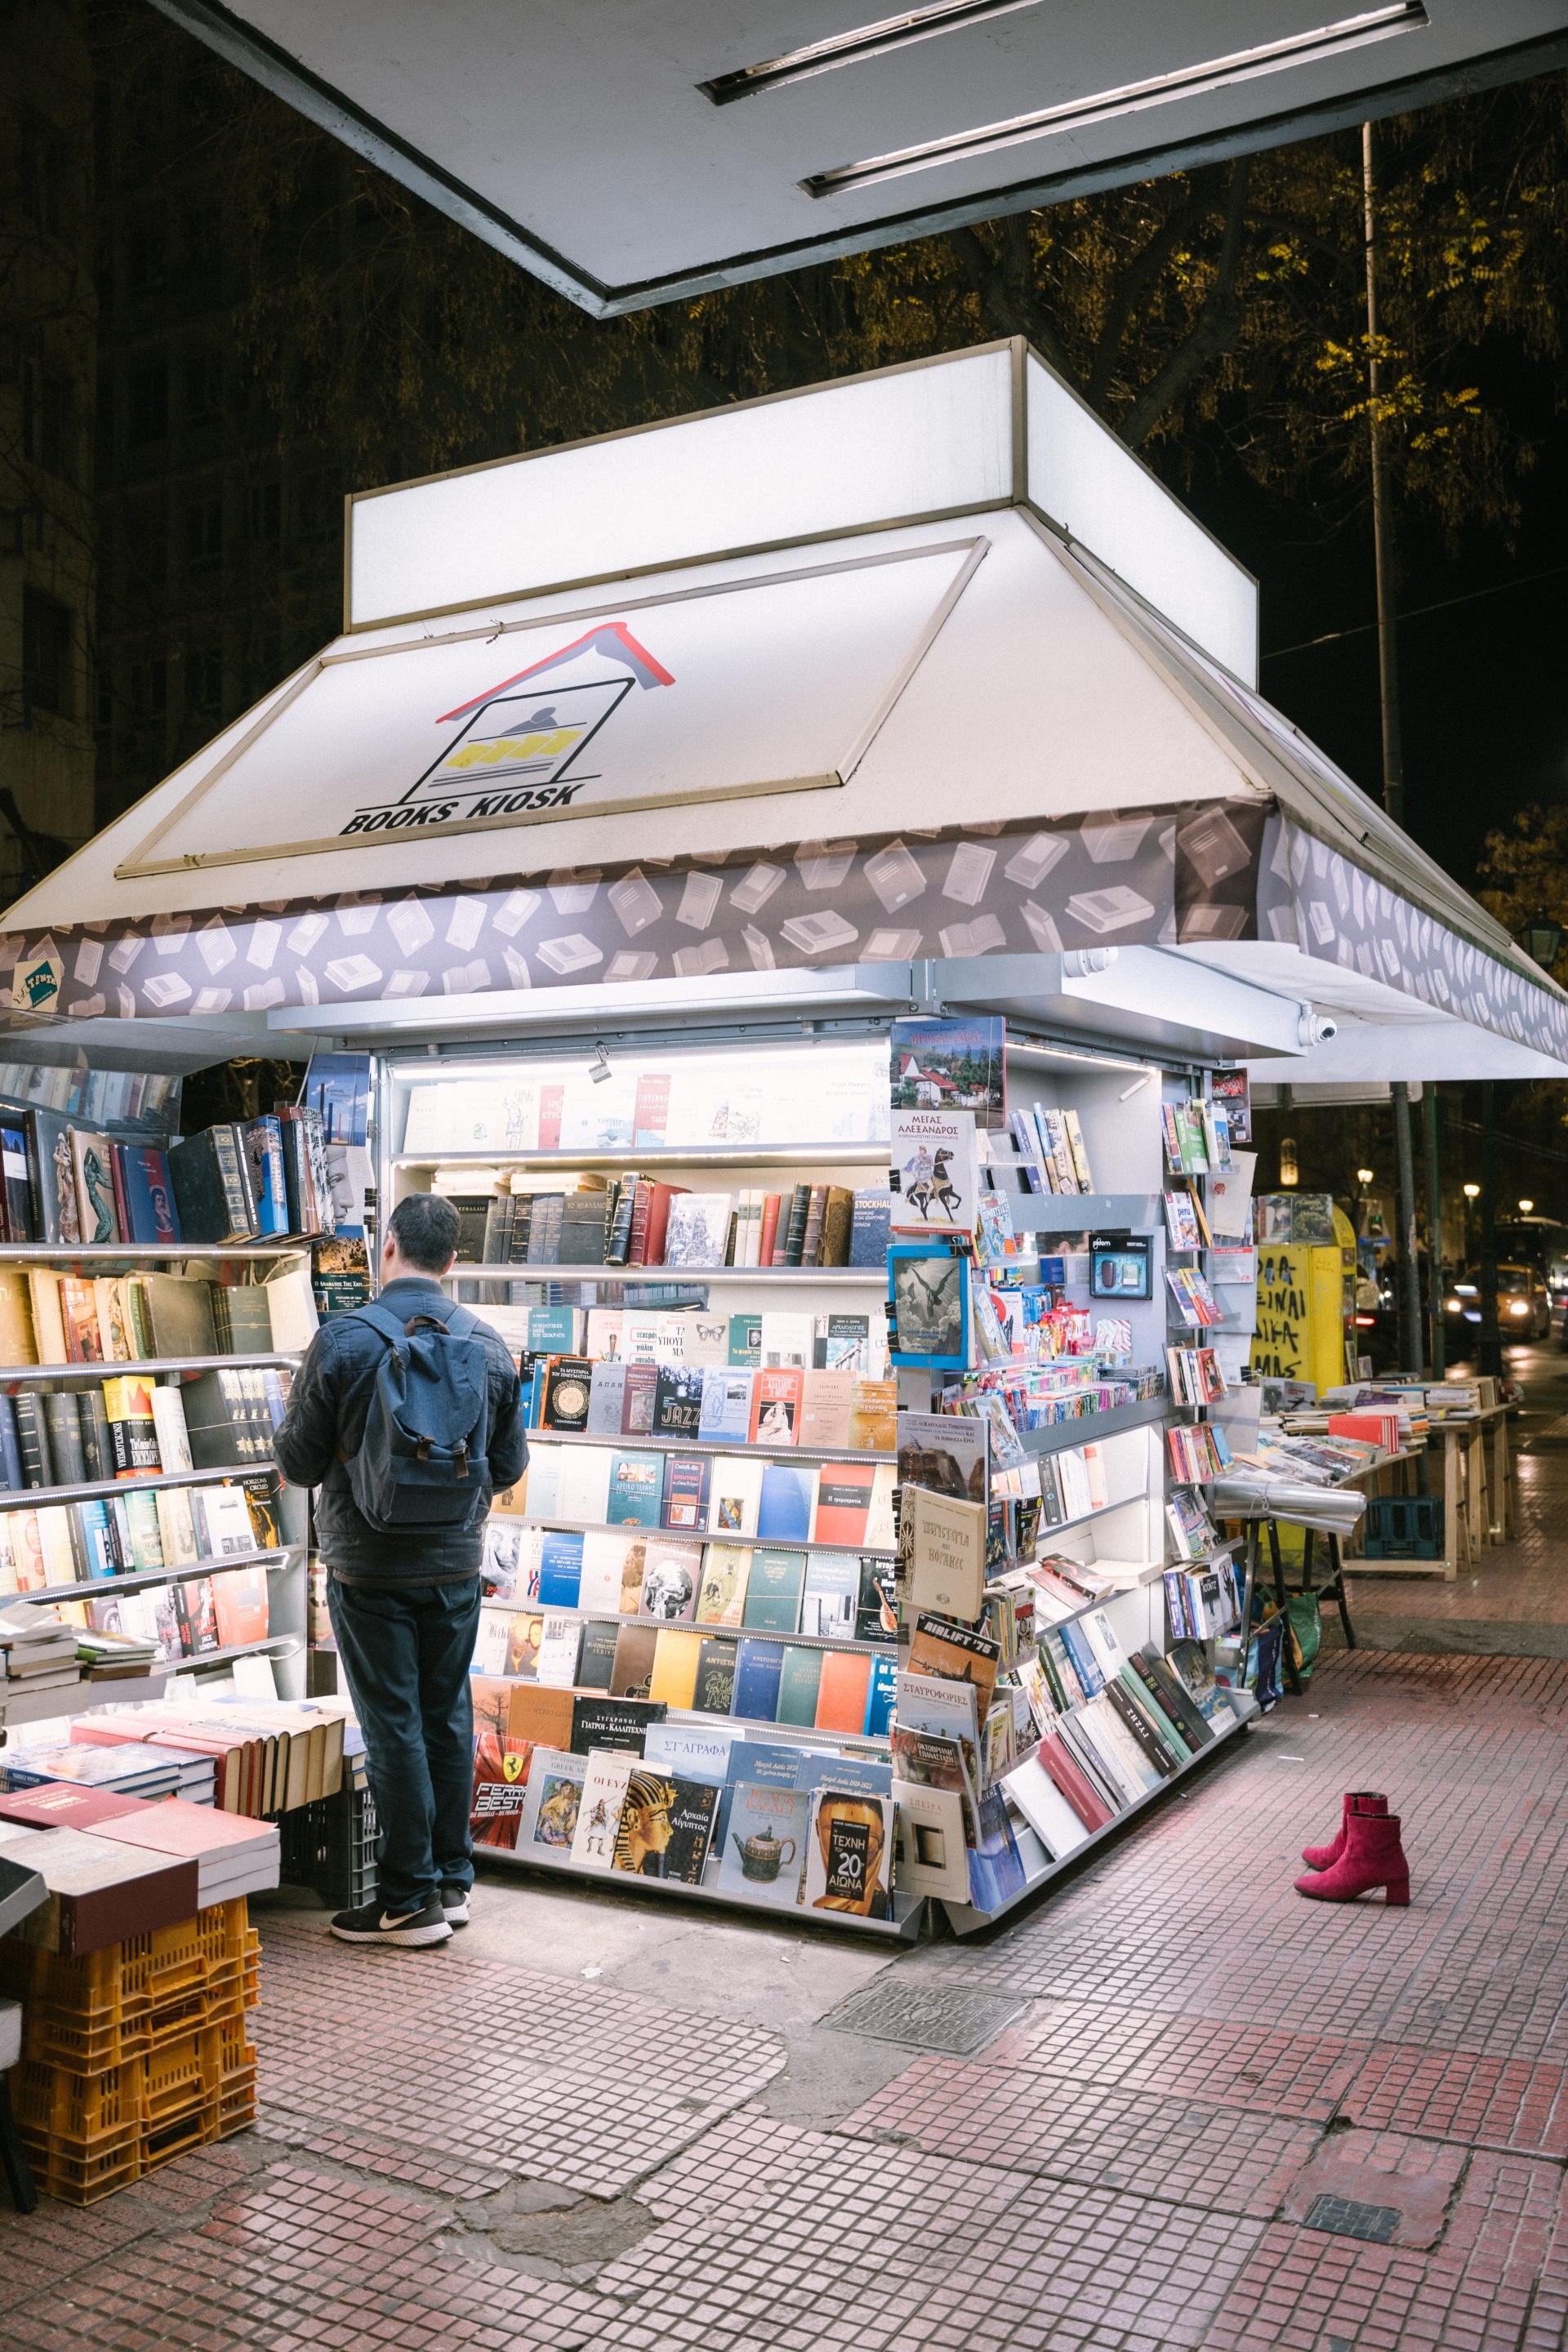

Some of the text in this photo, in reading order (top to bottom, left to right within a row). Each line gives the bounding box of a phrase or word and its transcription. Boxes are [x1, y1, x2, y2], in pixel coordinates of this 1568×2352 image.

[339, 783, 586, 836] BOOKS KIOSK
[911, 1030, 979, 1045] MPUMALANGA
[911, 1116, 942, 1125] ΜΕΓΑΣ
[898, 1125, 959, 1135] ΑΛΕΞΑΝΔΡΟΣ
[854, 1200, 891, 1209] STOCKHAU
[1178, 1207, 1191, 1219] peru
[129, 1286, 146, 1352] ΝΟΜΟΣ ΛΑΡΙΣΗΣ
[661, 1405, 700, 1425] JAZZ
[947, 1423, 974, 1432] ΤΡΙΚΟΥΠΗΣ
[113, 1422, 126, 1468] ENCYCLOPEDIA
[940, 1435, 963, 1443] ΔΗΜΟΣΙΑ
[243, 1477, 267, 1486] HORIZONS
[249, 1483, 268, 1491] CIRCLED
[616, 1482, 655, 1493] ΛΕΞΙΚΟ ΤΕΧΝΗΣ
[1202, 1580, 1217, 1593] KOONTZ
[201, 1633, 212, 1644] JACK
[924, 1621, 992, 1655] AIRLIFT '75
[198, 1640, 218, 1651] LONDON
[706, 1656, 735, 1667] ΑΝΤΙΣΤΑ
[903, 1683, 969, 1705] ΣΤΑΥΡΟΦΟΡΙΕΣ
[596, 1715, 636, 1725] ΣΥΓΧΡΟΝΟΙ
[1125, 1708, 1150, 1738] ΓΥΖΗΣ
[581, 1720, 648, 1735] ΓΙΑΤΡΟΙ ΚΑΛΛΙΤΕΧΝΕ
[917, 1743, 953, 1756] ΟΚΤΩΒΡΙΑΝΗ
[918, 1749, 954, 1763] ΕΠΑΝΑΣΤΑΣΗ
[551, 1762, 575, 1773] GREEK
[754, 1760, 773, 1769] Μικρά
[773, 1762, 786, 1770] Ασία
[594, 1775, 627, 1789] ΟΙ ΕΥΖ
[820, 1774, 873, 1790] Μικρά Ασία 1919-1922
[474, 1796, 523, 1811] BEST
[749, 1788, 795, 1805] BLACK
[745, 1798, 794, 1815] BASALT
[909, 1797, 942, 1812] ΣΠΕΙΡΑ
[680, 1809, 709, 1823] Αρχαία
[670, 1816, 707, 1834] Αίγυπτος
[832, 1833, 866, 1851] ΤΕΧΝΗ
[828, 1874, 862, 1891] ΑΙΩΝΑ
